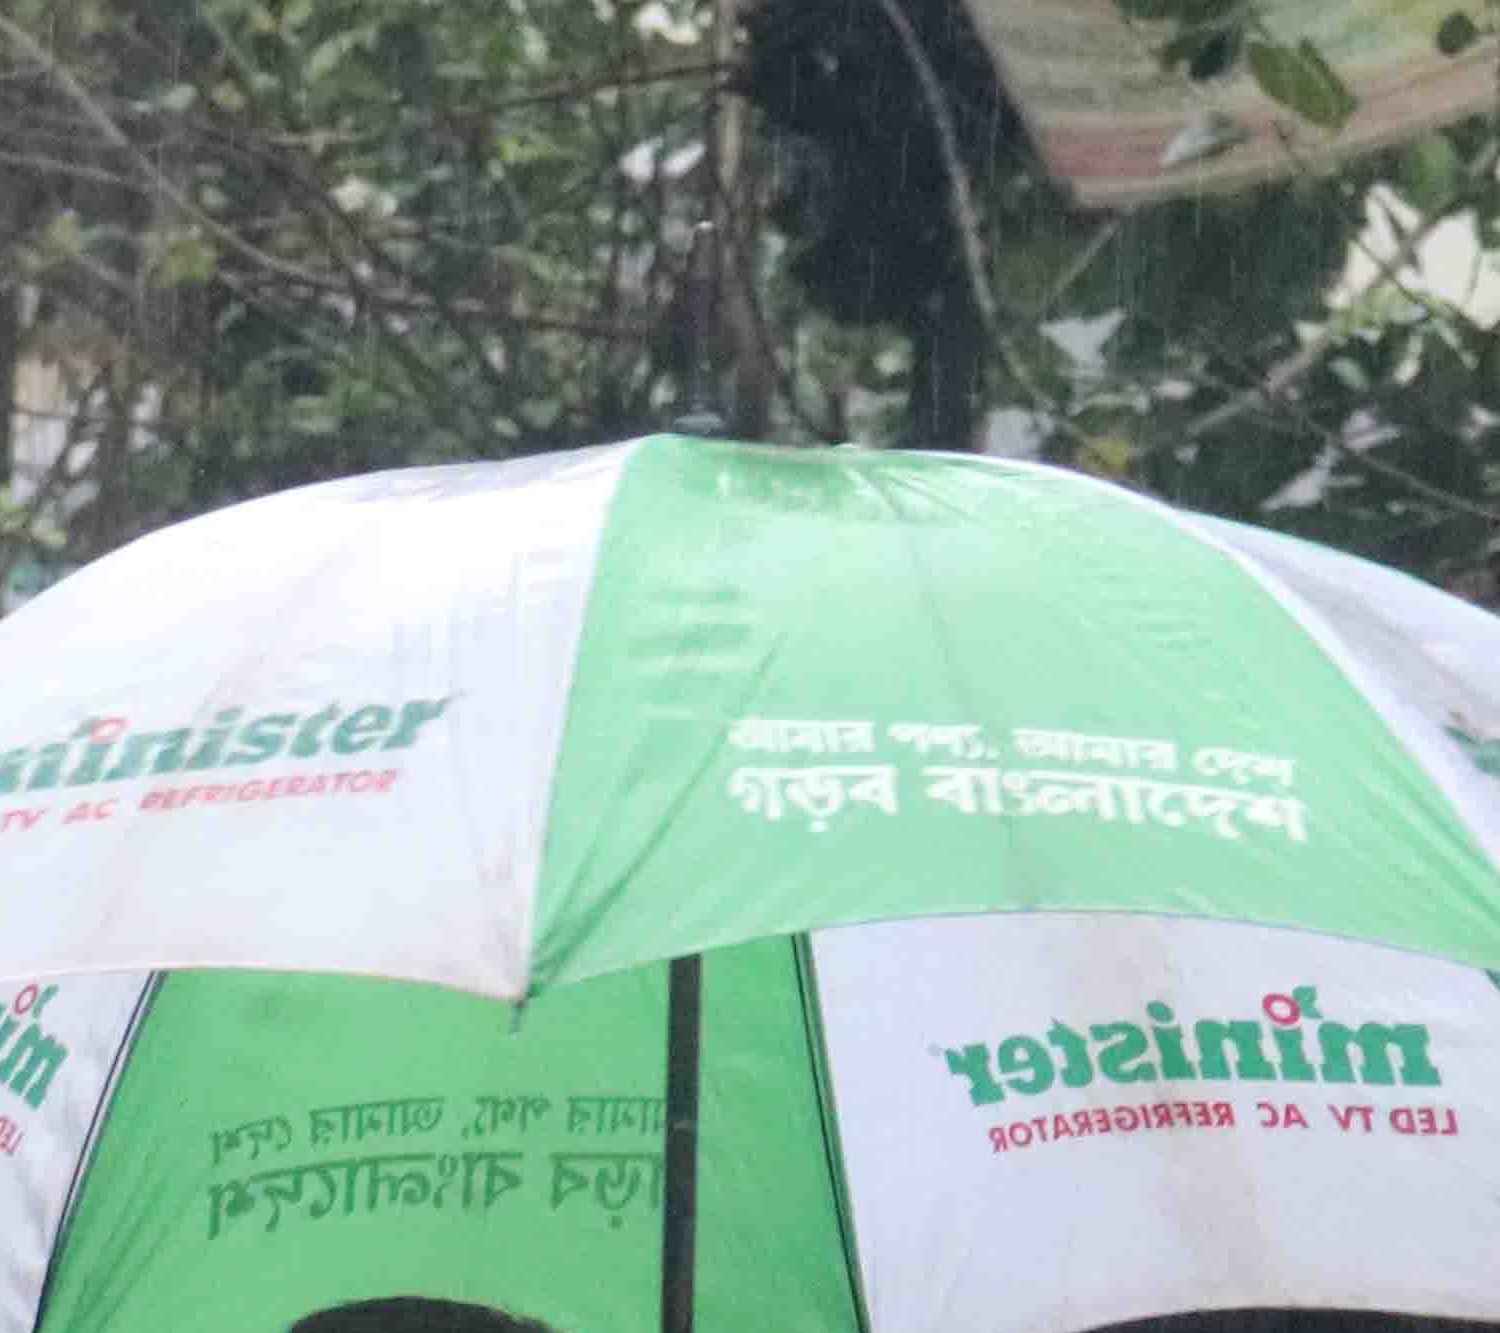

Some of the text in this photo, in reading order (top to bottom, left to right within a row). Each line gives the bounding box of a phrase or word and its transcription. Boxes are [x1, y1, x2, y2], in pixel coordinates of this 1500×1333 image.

[729, 718, 875, 754] আমার
[1012, 727, 1178, 772] আমার
[1192, 746, 1298, 787] দেশ
[63, 797, 122, 826] AC
[137, 766, 402, 812] REFRIGERATOR
[726, 764, 1308, 843] গড়ব বাংলাদেশ
